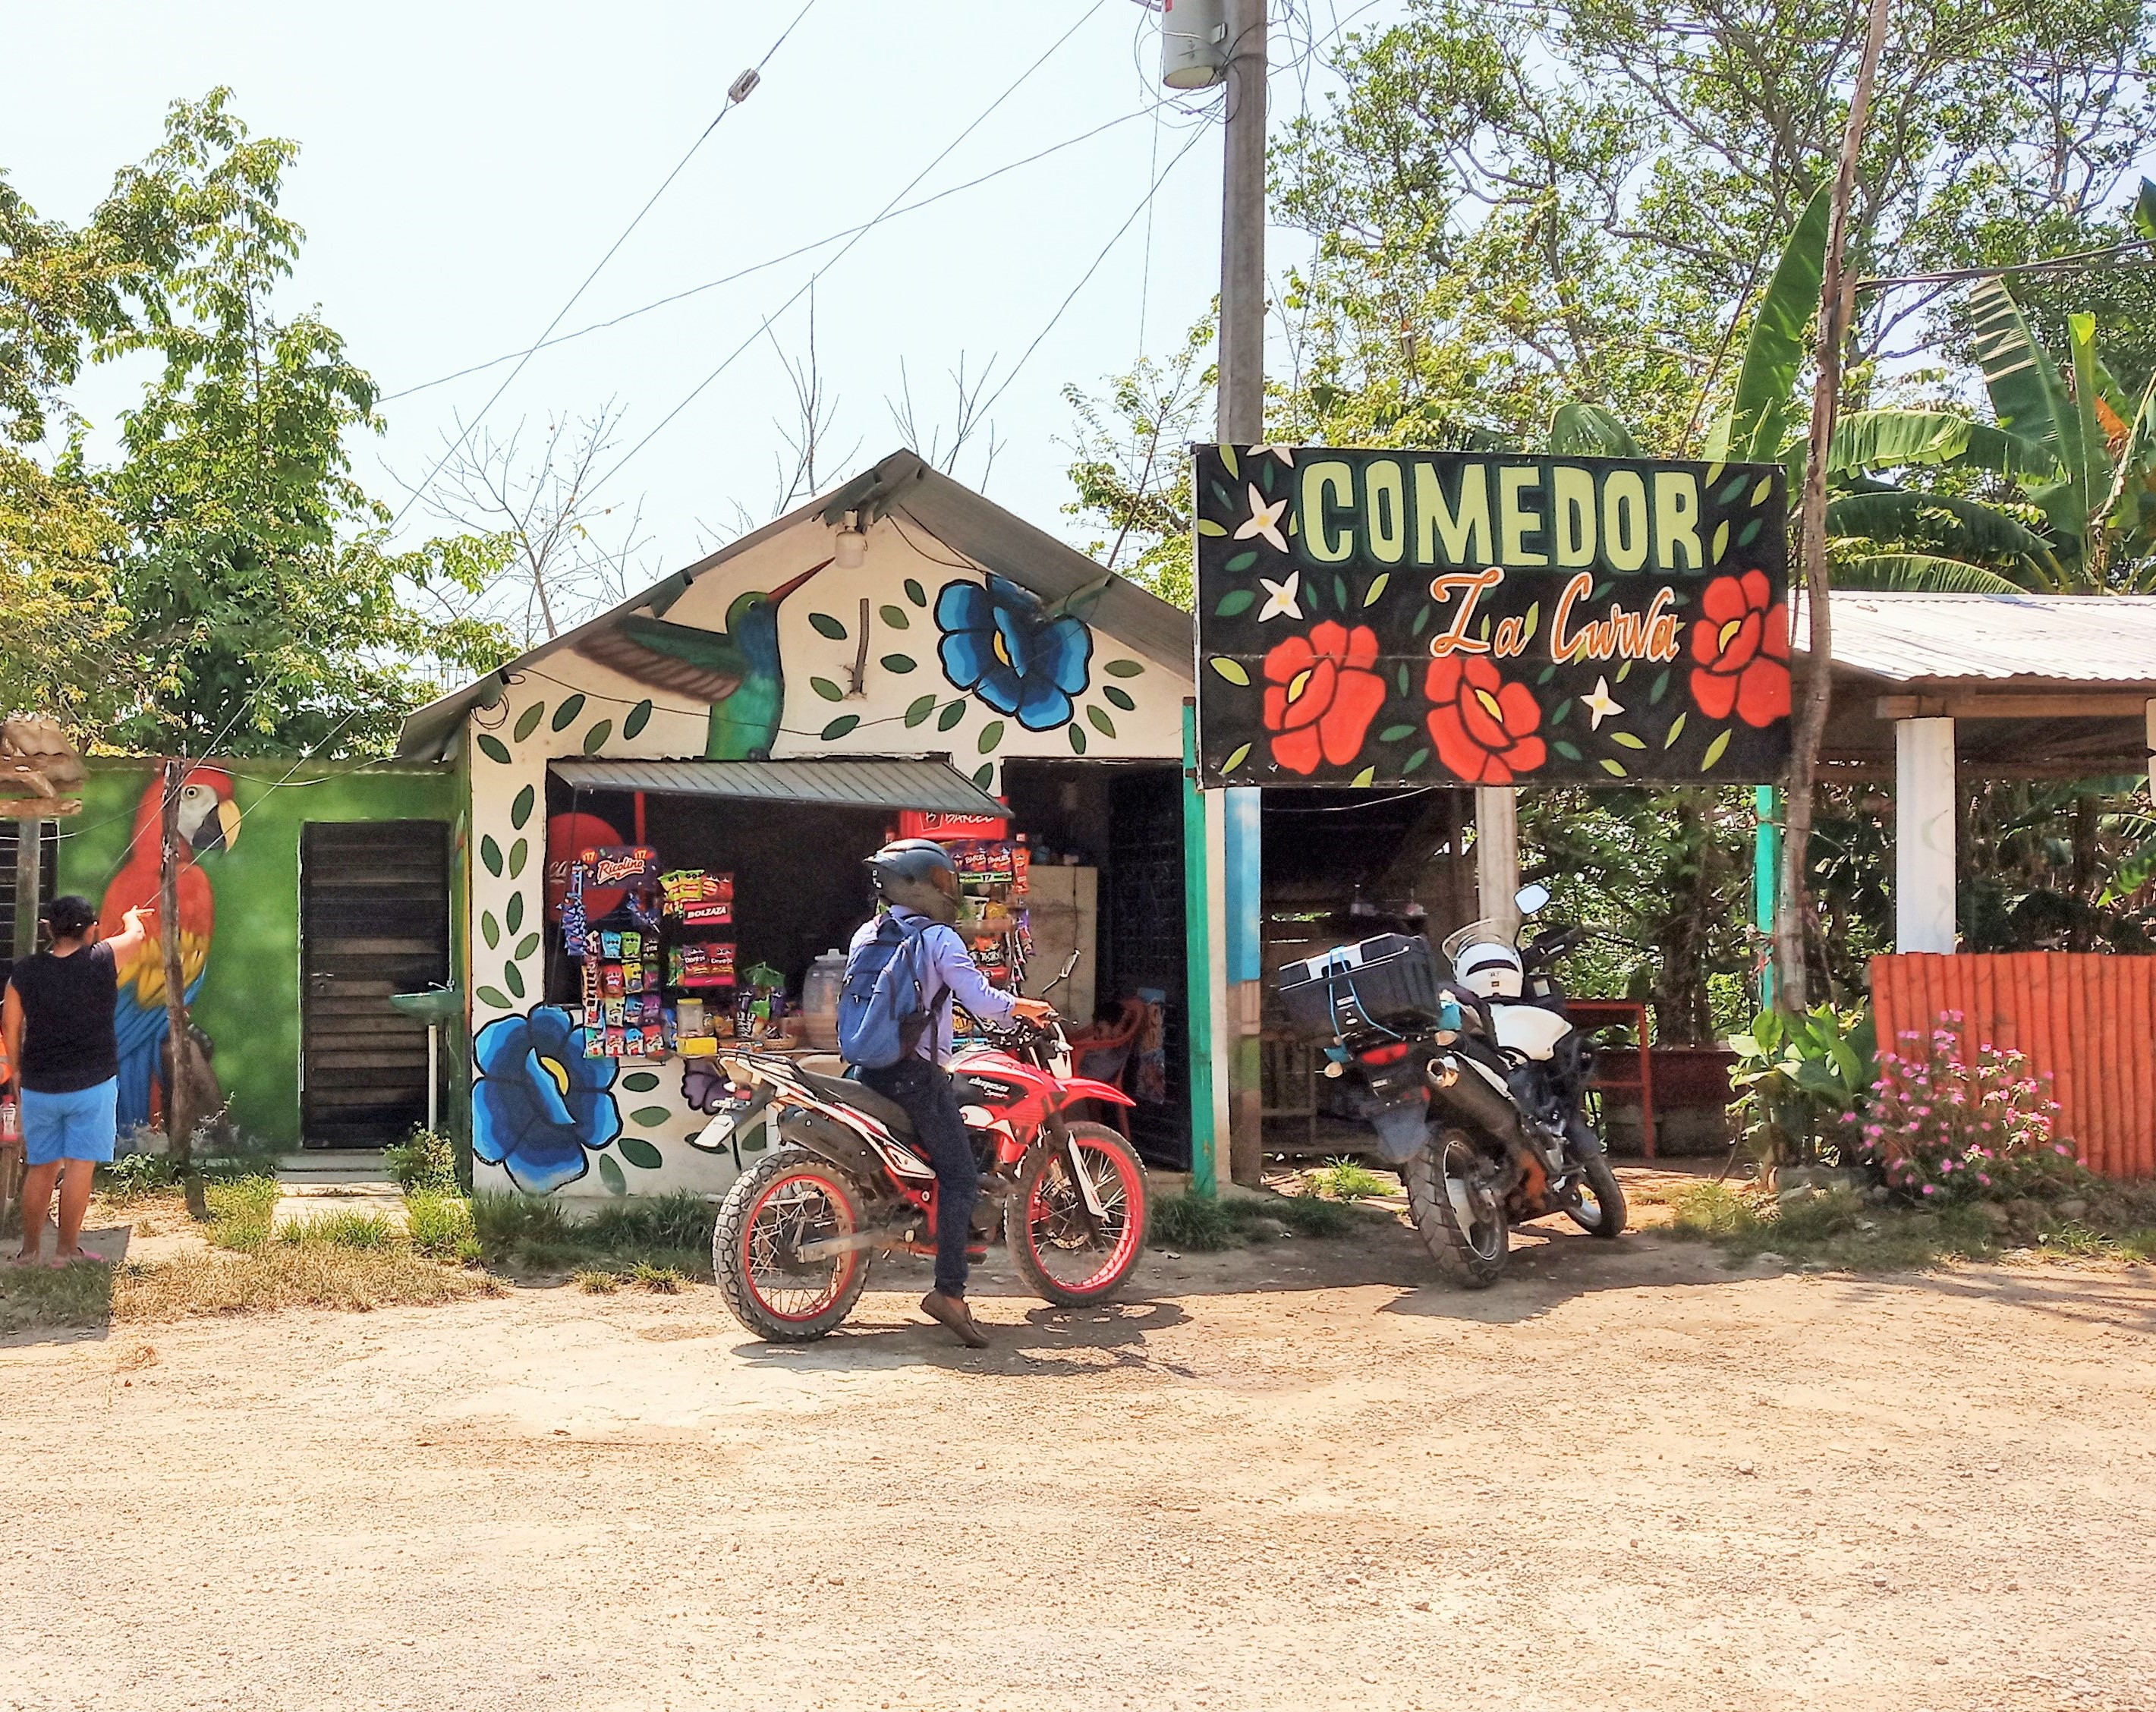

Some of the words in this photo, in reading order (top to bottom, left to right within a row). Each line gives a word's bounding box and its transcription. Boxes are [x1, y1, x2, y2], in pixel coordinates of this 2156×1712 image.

[1300, 459, 1704, 571] COMEDOR
[1430, 566, 1527, 657] La
[1550, 571, 1681, 664] Curva
[598, 856, 645, 883] Ricolino
